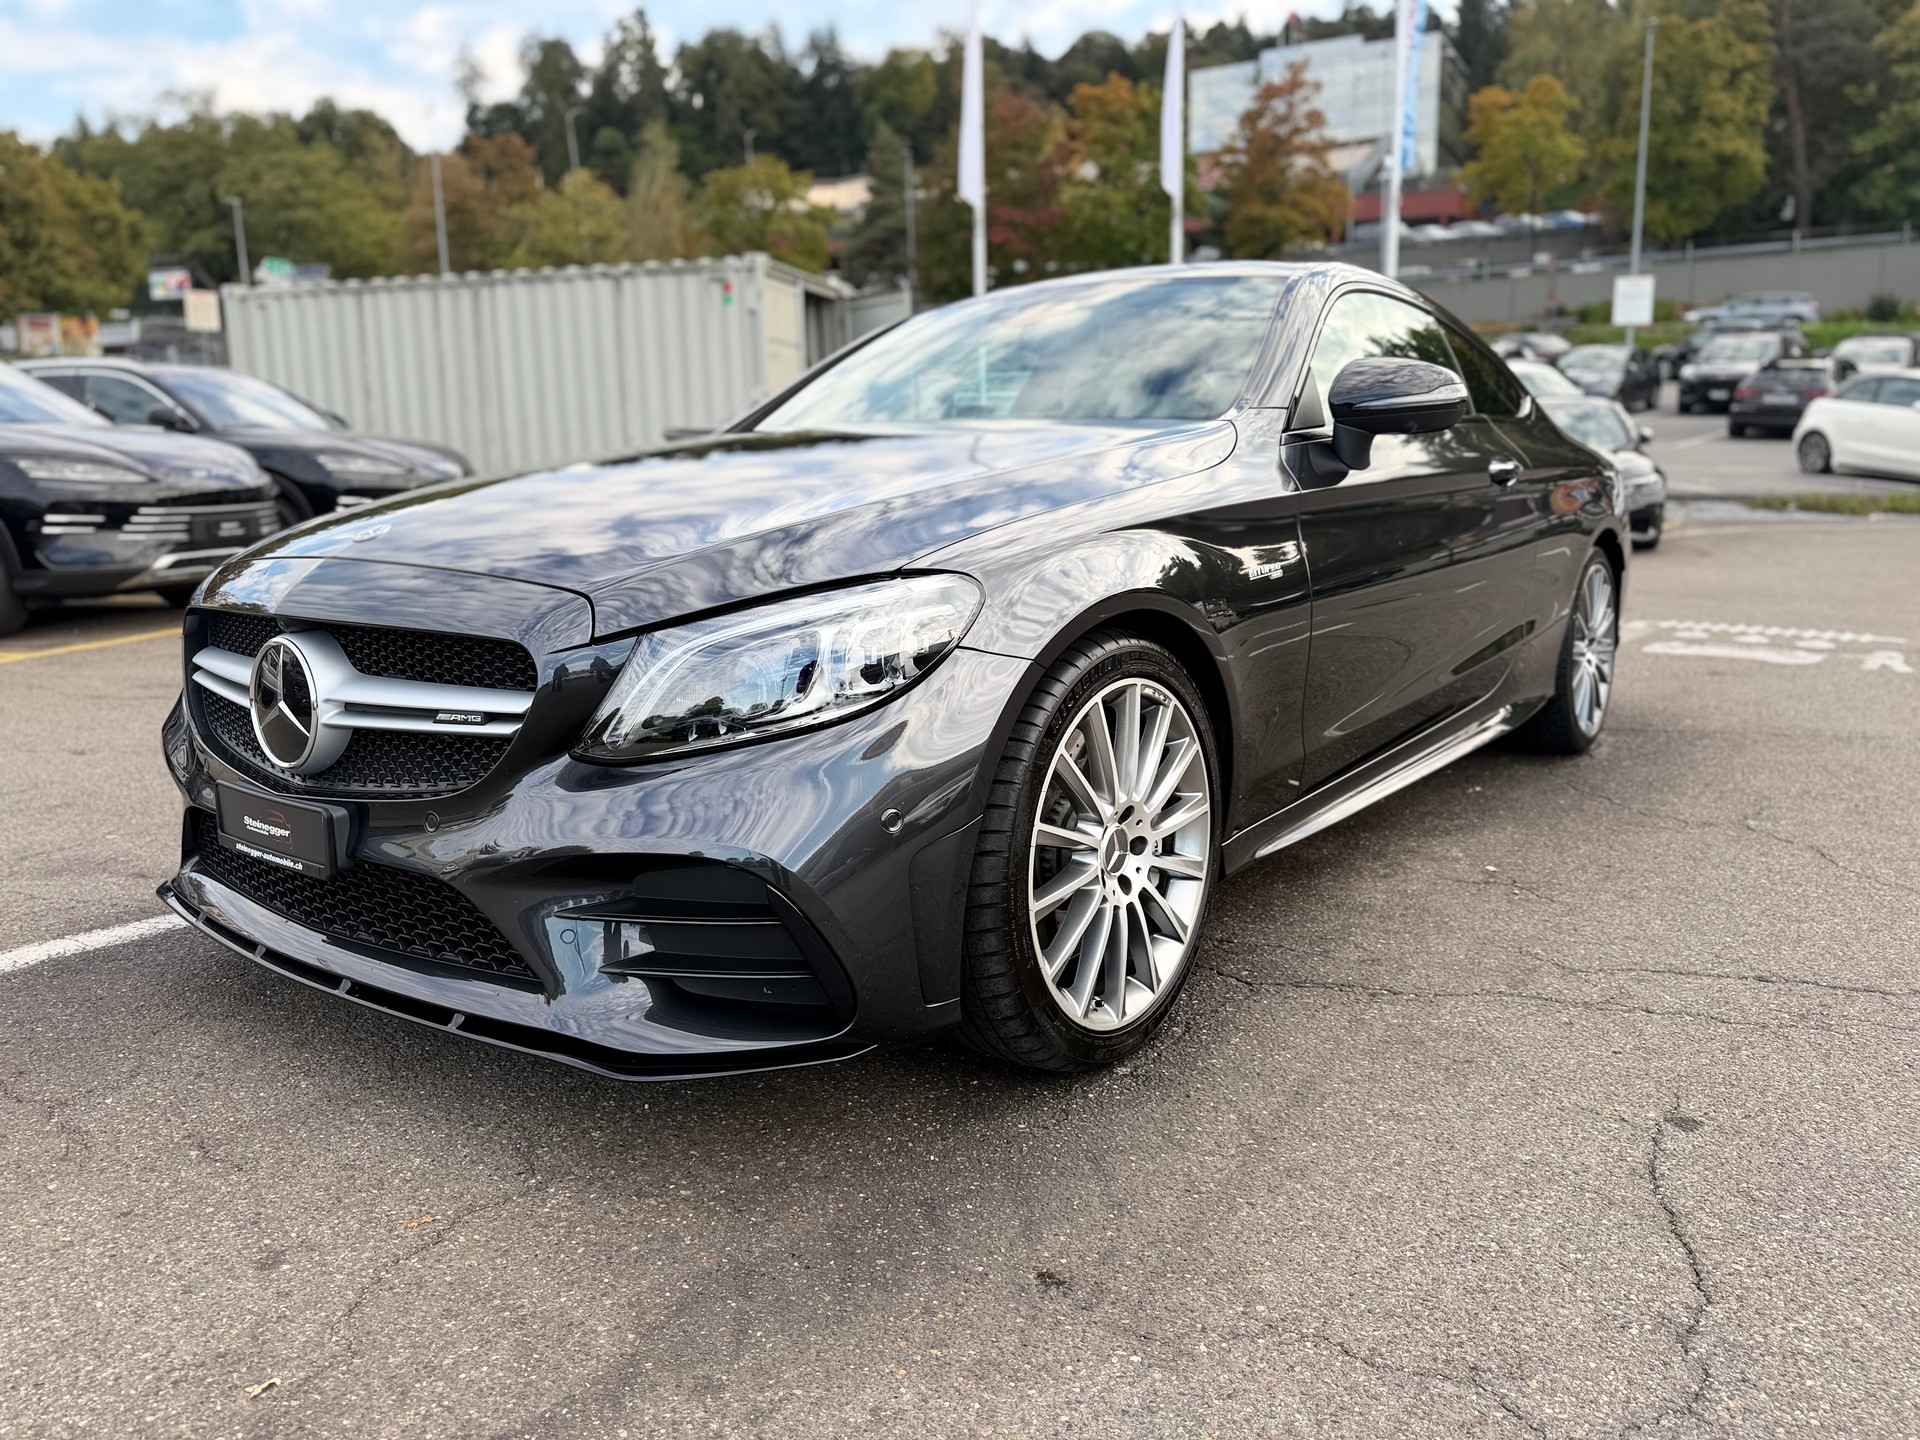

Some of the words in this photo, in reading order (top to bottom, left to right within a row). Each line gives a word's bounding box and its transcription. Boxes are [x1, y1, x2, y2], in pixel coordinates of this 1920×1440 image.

[1051, 656, 1112, 735] MICHELIN
[449, 714, 482, 722] AMG
[243, 815, 290, 837] Steinegger
[235, 843, 303, 870] steinegger-automobile.ch
